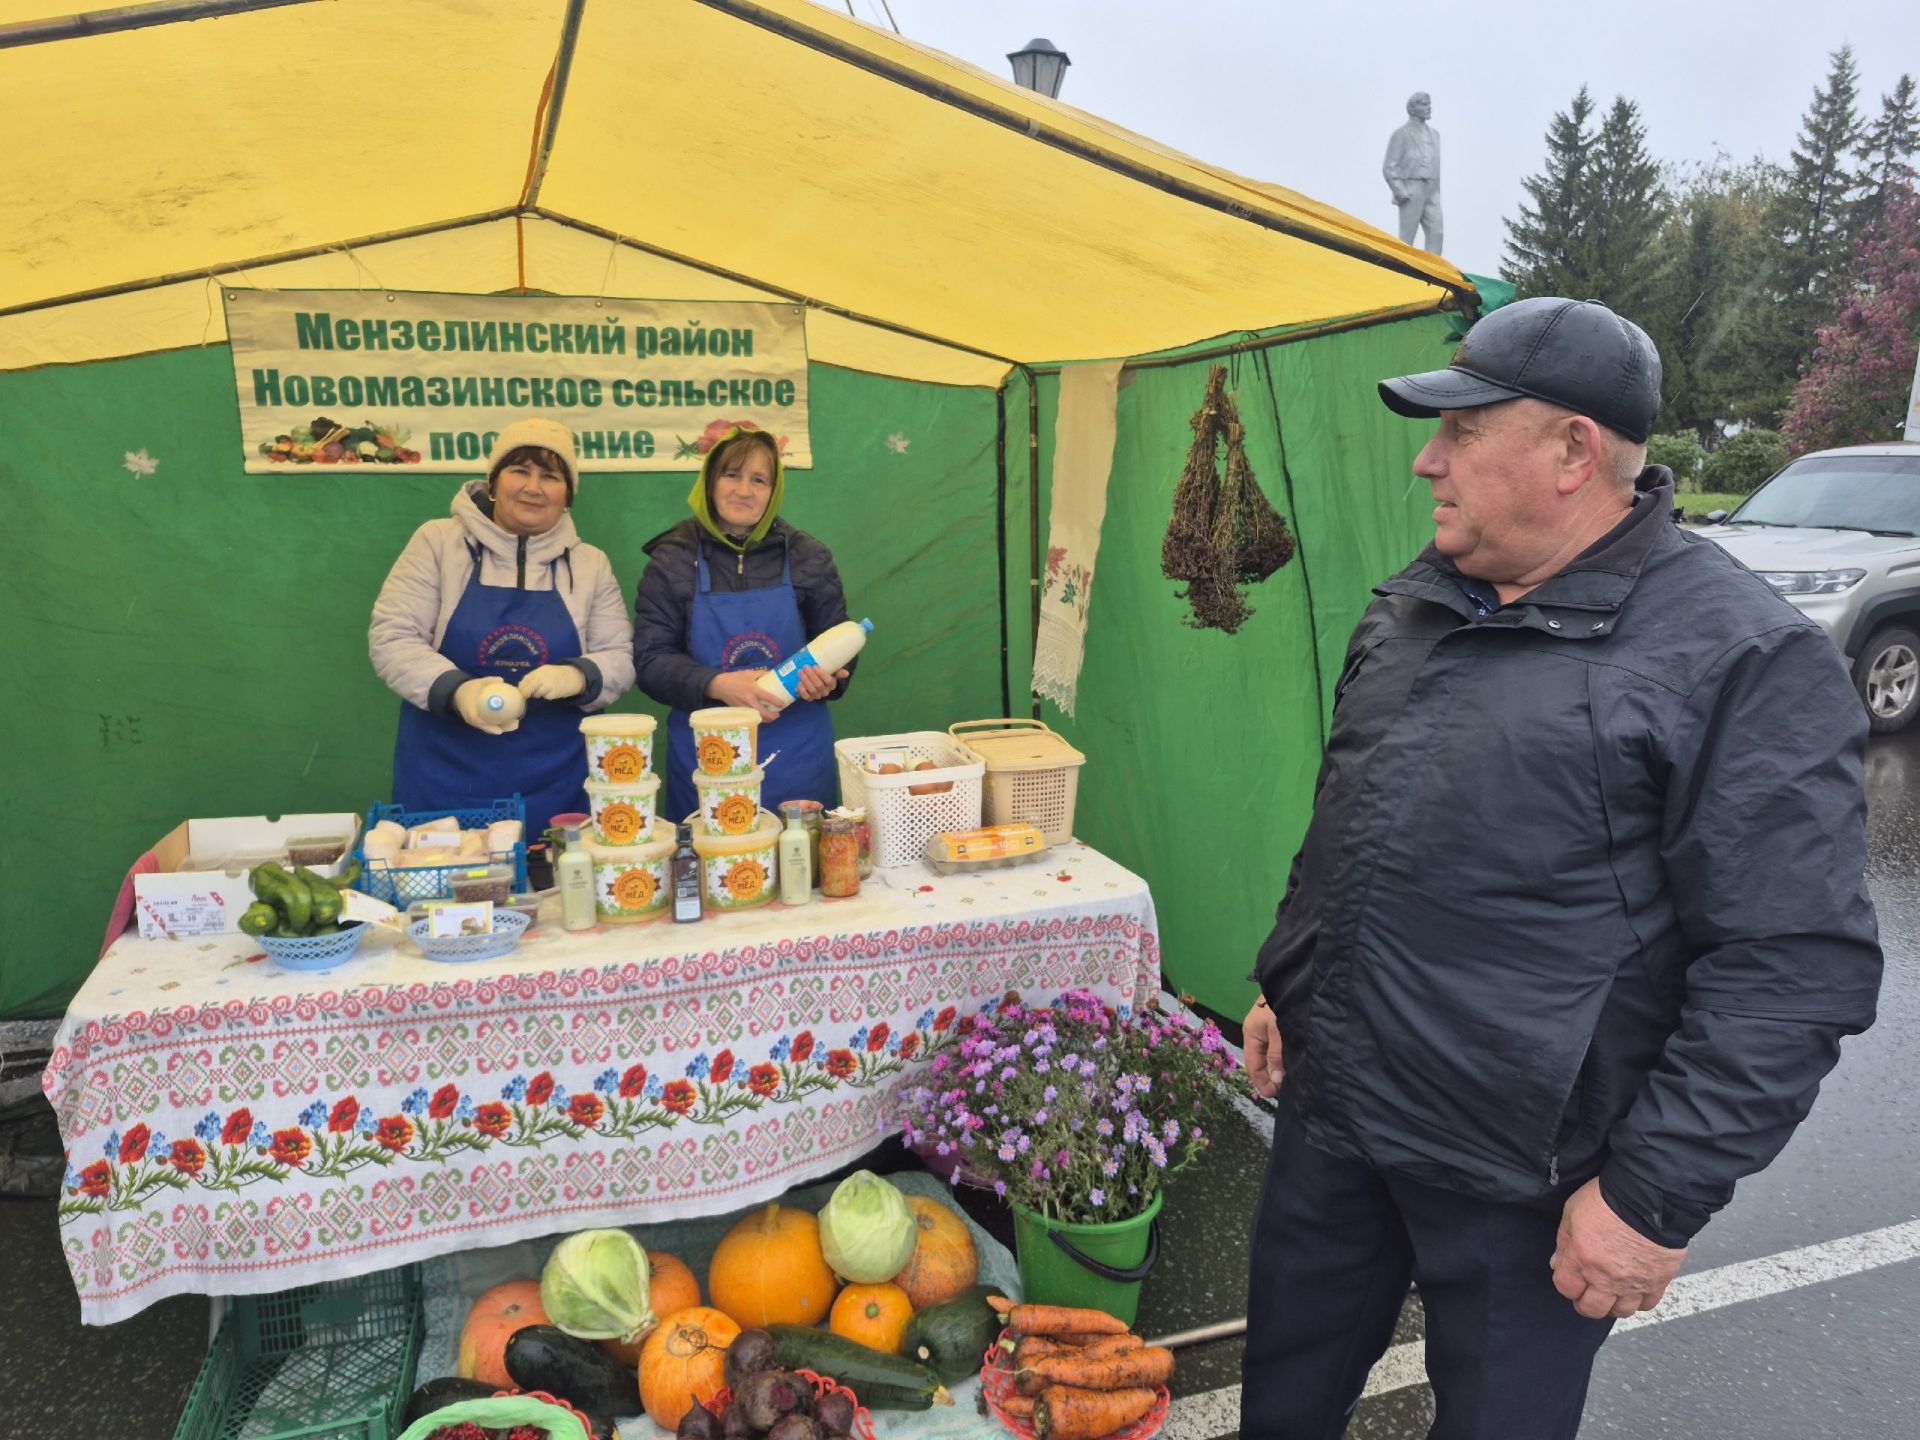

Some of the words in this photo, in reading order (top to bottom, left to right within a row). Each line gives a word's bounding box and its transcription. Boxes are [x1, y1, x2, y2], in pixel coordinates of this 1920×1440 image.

[294, 311, 626, 355] Мензелинский
[635, 319, 753, 360] район
[252, 368, 603, 408] Новомазинское
[612, 378, 796, 408] сельское
[429, 429, 656, 461] посние
